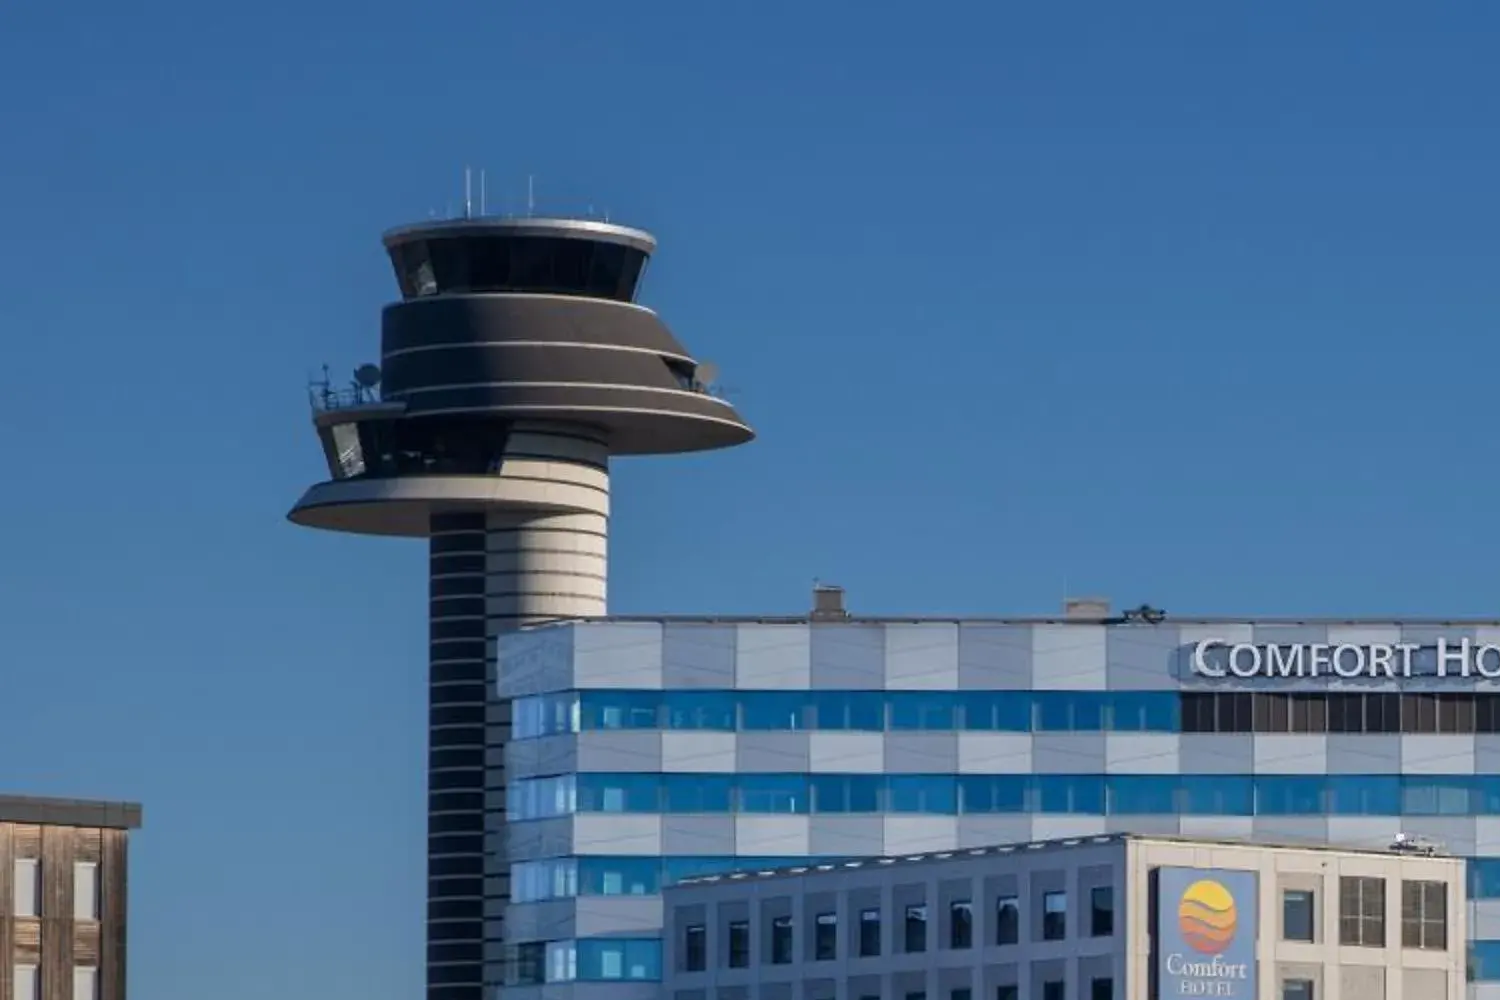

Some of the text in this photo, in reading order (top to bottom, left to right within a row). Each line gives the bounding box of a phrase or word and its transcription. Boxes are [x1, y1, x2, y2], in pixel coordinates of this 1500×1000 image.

[1193, 637, 1420, 678] COMFORT
[1166, 953, 1247, 978] Comfort
[1180, 980, 1234, 996] HOTEL
